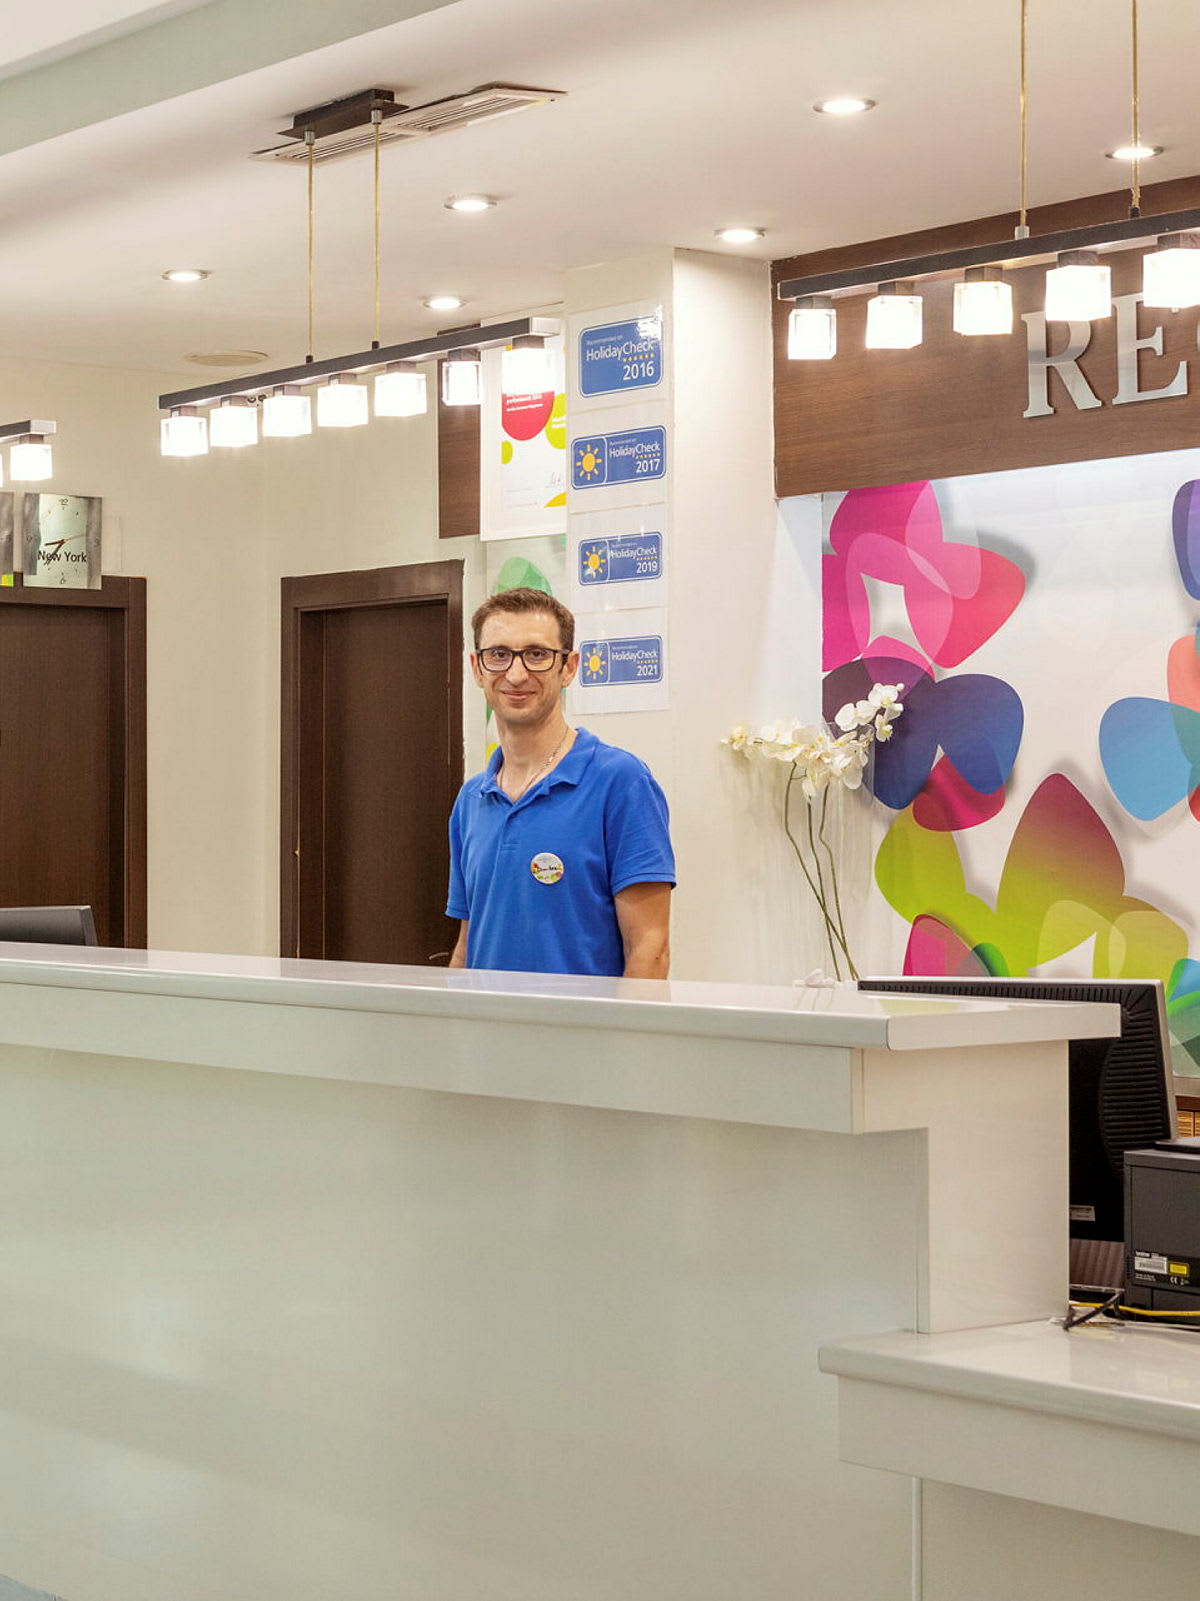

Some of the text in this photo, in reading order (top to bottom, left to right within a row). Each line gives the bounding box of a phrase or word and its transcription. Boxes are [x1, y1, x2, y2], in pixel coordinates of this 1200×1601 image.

[586, 340, 654, 361] HolidayCheck
[1021, 292, 1200, 419] RE
[623, 360, 654, 381] 2016
[609, 441, 660, 458] HolidayCheck
[635, 458, 660, 474] 2017
[38, 551, 87, 562] New York
[610, 545, 658, 559] HolidayCheck
[636, 560, 658, 574] 2019
[611, 649, 658, 662] HolidayCheck
[636, 664, 658, 677] 2021
